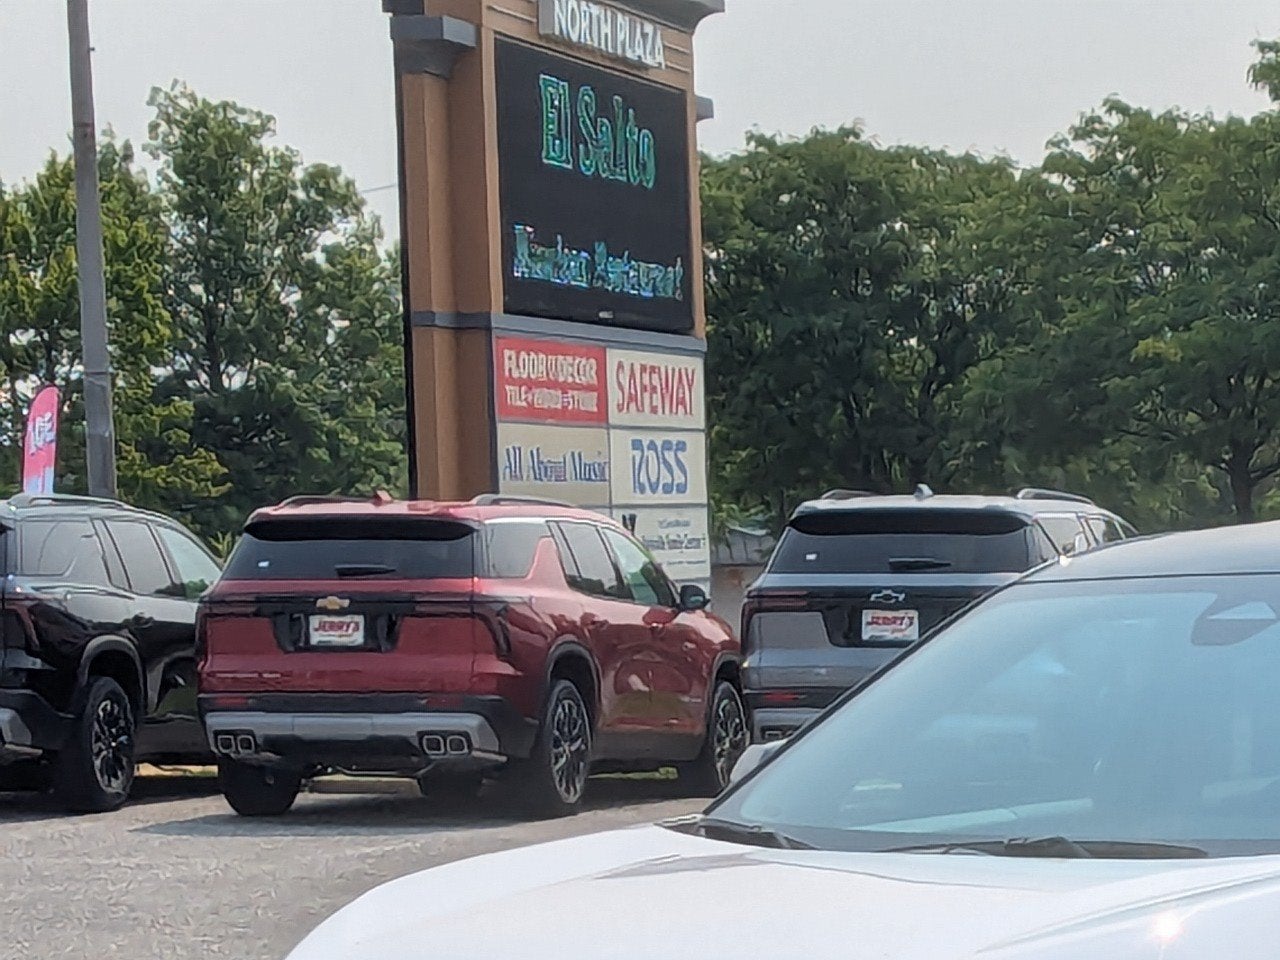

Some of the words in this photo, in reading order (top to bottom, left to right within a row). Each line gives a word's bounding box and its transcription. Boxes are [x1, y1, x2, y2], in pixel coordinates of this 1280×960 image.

[554, 0, 612, 53] NORTH
[617, 12, 665, 70] PLAZA
[539, 73, 572, 169] El
[577, 85, 656, 189] Salto
[616, 360, 695, 416] SAFEWAY
[502, 445, 523, 482] All
[631, 438, 688, 495] ROSS
